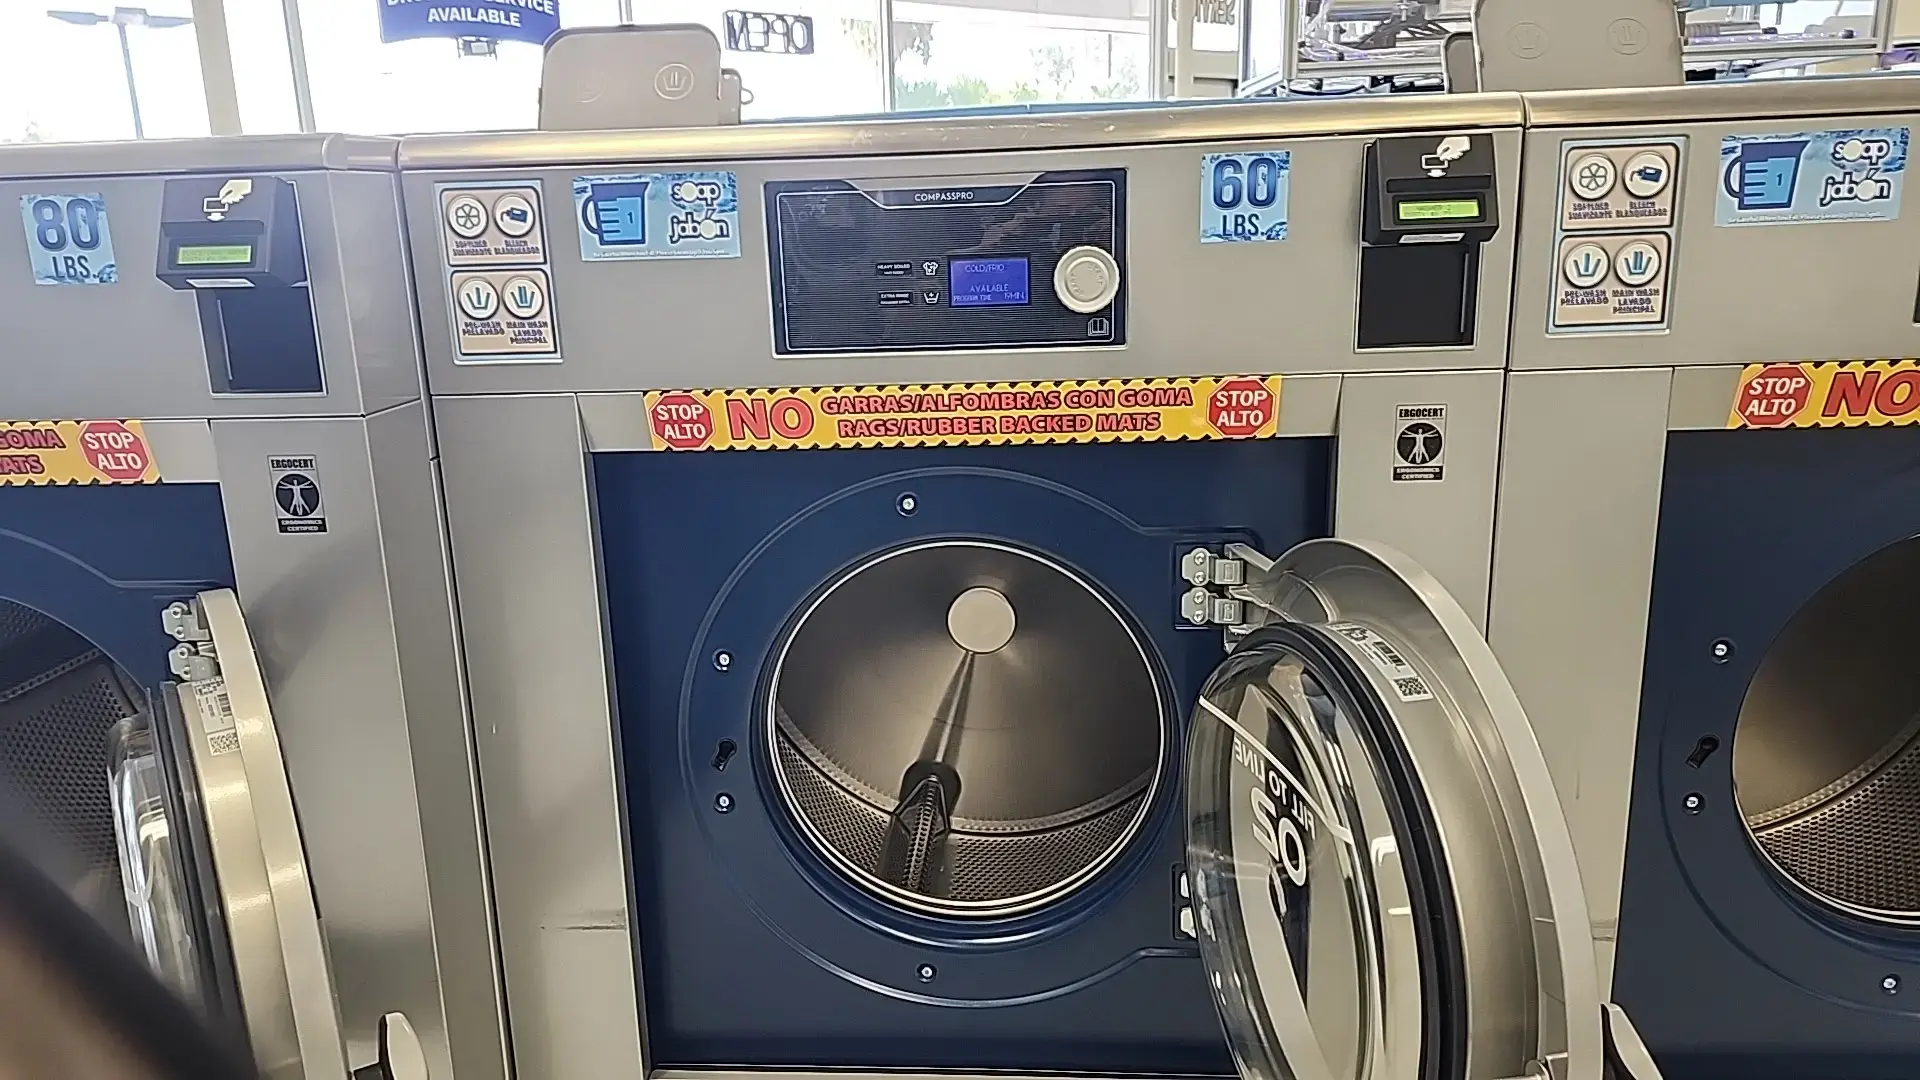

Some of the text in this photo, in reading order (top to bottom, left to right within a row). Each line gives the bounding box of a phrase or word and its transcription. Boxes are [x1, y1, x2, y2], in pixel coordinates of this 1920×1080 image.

[428, 8, 521, 27] AVAILABLE
[1832, 138, 1890, 166] soap
[1213, 158, 1277, 209] 60
[1820, 168, 1891, 207] jabón
[671, 181, 721, 207] soap
[915, 191, 974, 201] COMPASSPRO
[32, 199, 101, 251] 80
[669, 209, 730, 244] jabón
[1222, 213, 1265, 237] LBS.
[52, 255, 99, 278] LBS.
[970, 284, 1009, 292] AVAILABLE
[1749, 378, 1806, 395] STOP
[1821, 370, 1920, 417] NO
[821, 387, 1193, 415] GARRAS/ALFOMBRAS CON GOMA
[1215, 390, 1268, 407] STOP
[1744, 398, 1797, 416] ALTO
[656, 405, 704, 421] STOP
[727, 398, 814, 440] NO
[1216, 410, 1264, 427] ALTO
[1399, 408, 1444, 418] ERGOCERT
[663, 423, 707, 440] ALTO
[838, 412, 1161, 438] RAGS/RUBBER BACKED MATS
[83, 432, 135, 450] STOP
[0, 454, 46, 475] ATS
[97, 452, 142, 470] ALTO
[270, 459, 314, 468] ERGOCERT
